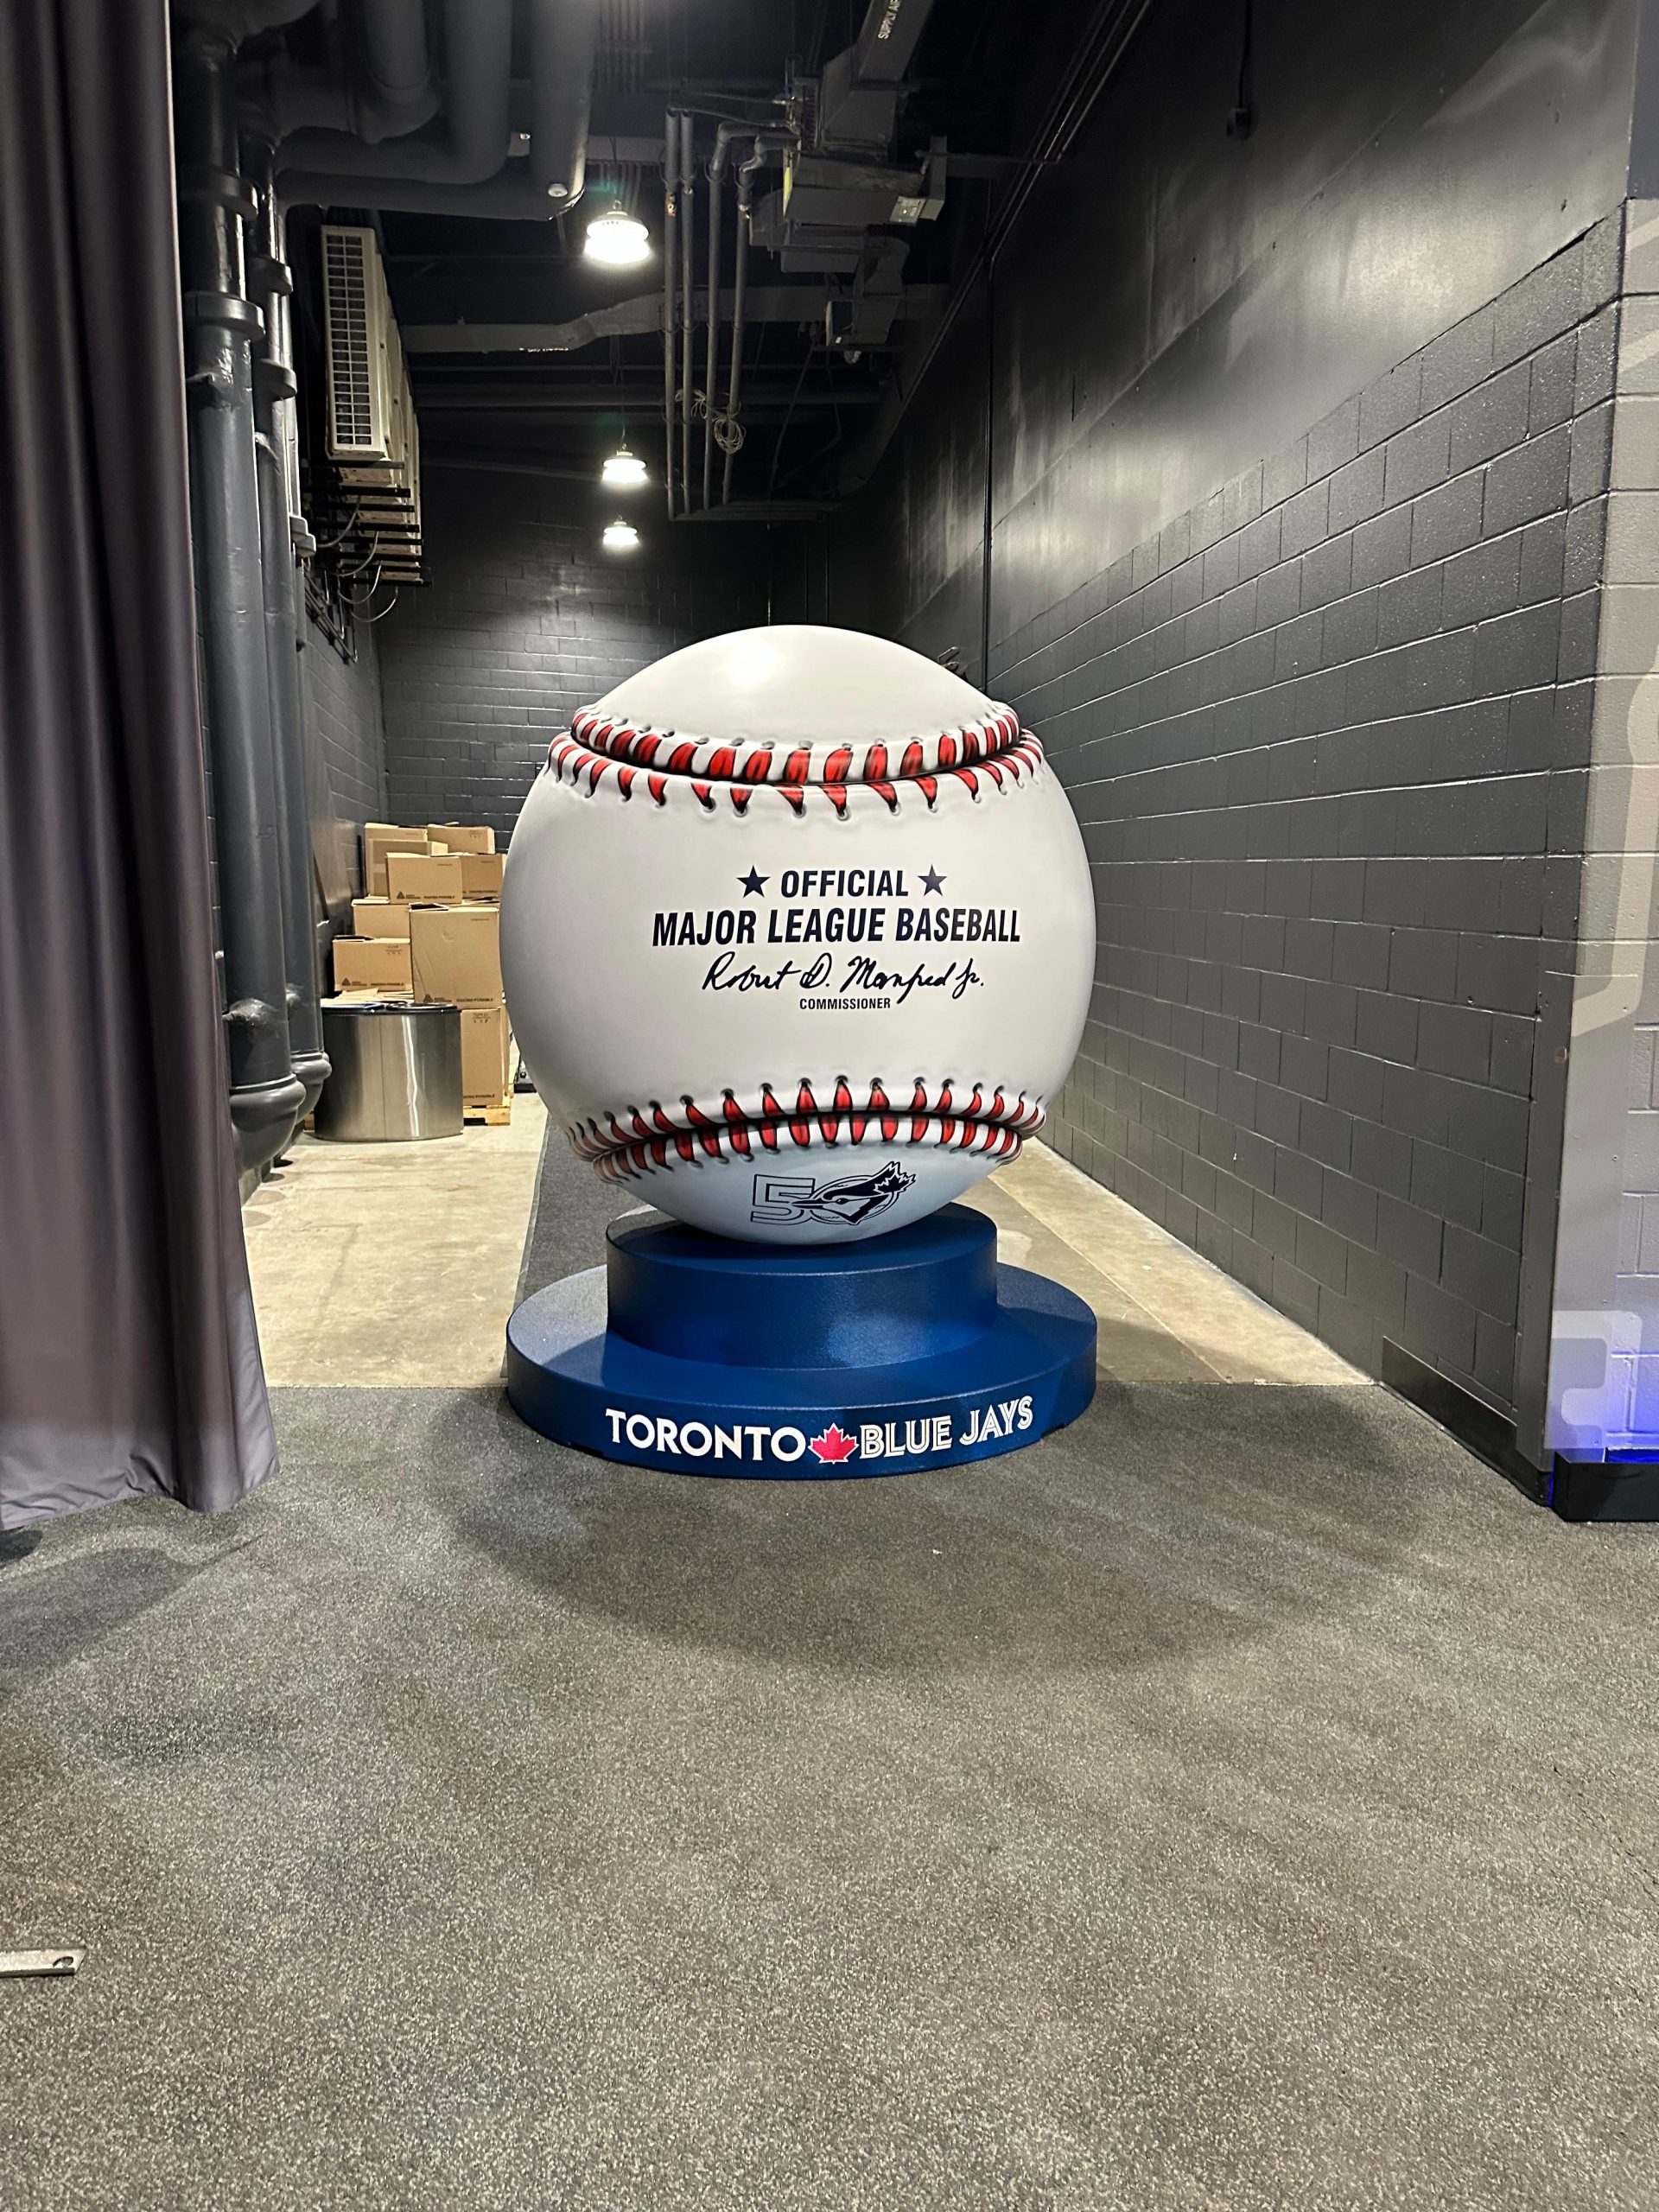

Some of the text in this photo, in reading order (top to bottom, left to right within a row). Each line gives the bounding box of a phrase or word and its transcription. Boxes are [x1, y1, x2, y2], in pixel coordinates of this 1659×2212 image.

[878, 11, 897, 39] SUPPLY
[780, 869, 909, 899] OFFICIAL
[652, 907, 1020, 947] MAJOR LEAGUE BASEBALL
[799, 997, 891, 1010] COMMISSIONER
[605, 1395, 1033, 1462] TORONTO BLUE JAYS
